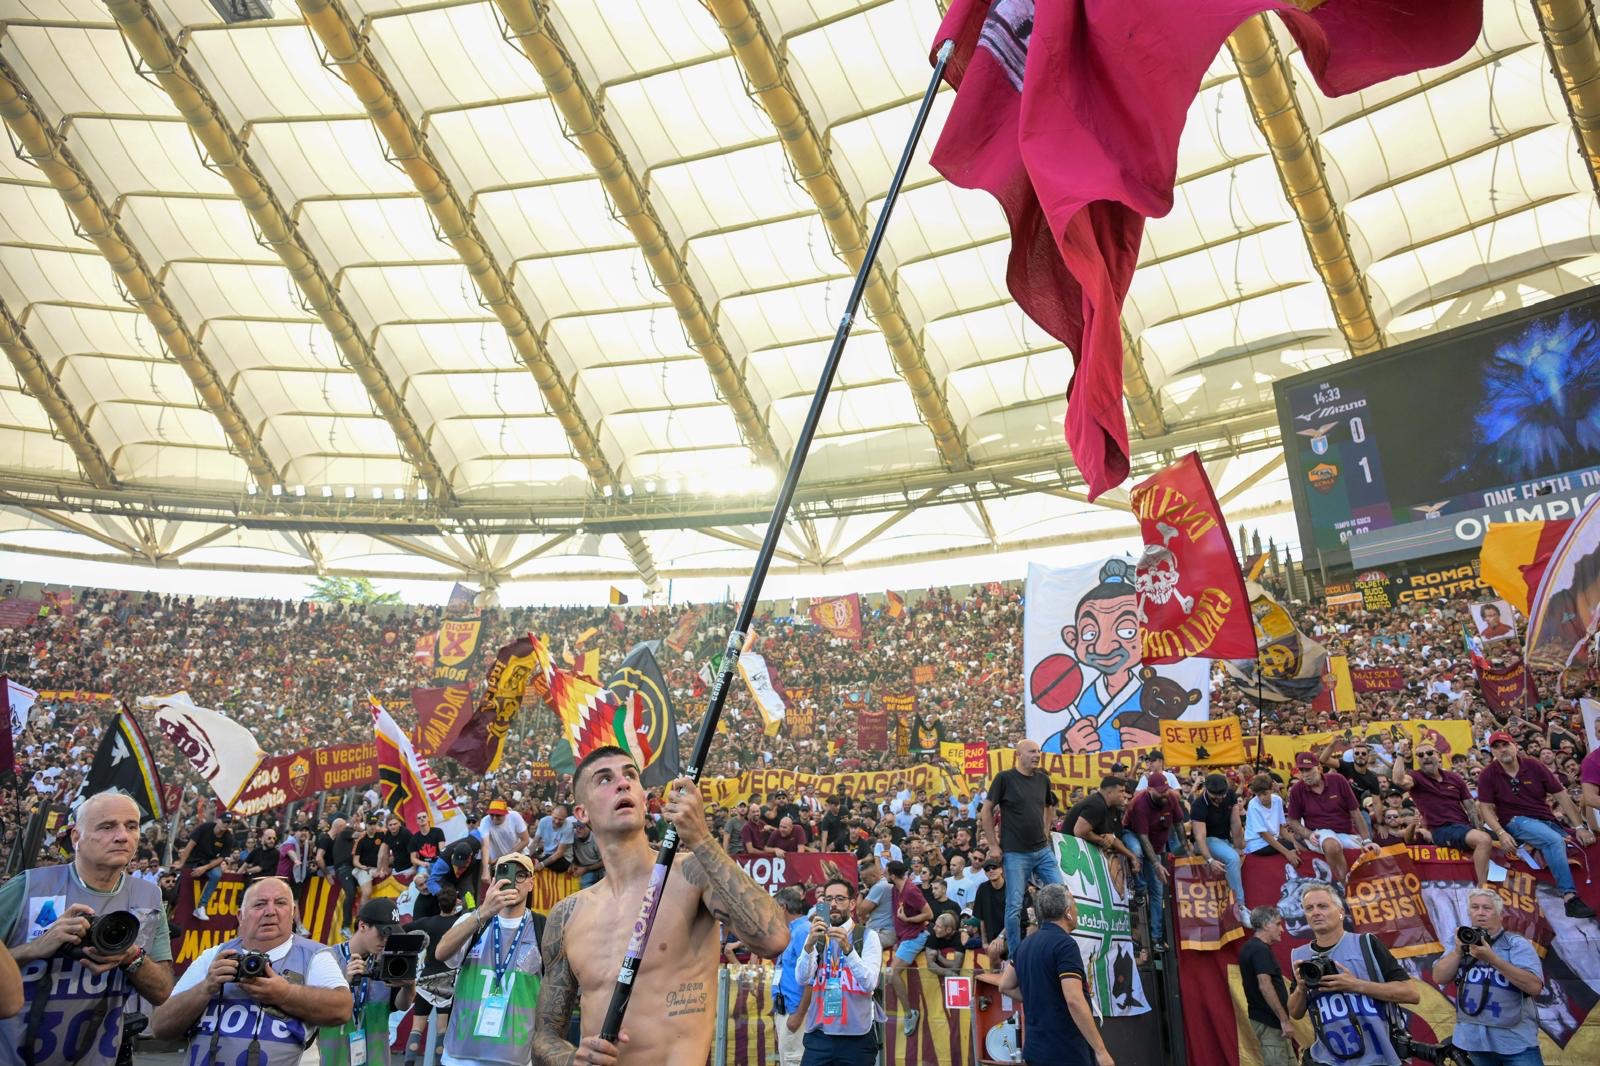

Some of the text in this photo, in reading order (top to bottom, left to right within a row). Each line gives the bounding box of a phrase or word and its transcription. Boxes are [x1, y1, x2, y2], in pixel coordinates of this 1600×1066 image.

[1313, 387, 1341, 405] 14:33
[1349, 417, 1365, 443] 0
[1359, 456, 1372, 483] 1
[1410, 565, 1473, 586] ROMA
[1165, 727, 1185, 744] SE
[315, 748, 329, 765] la
[324, 765, 373, 790] guardia
[1346, 873, 1421, 904] LOTITO
